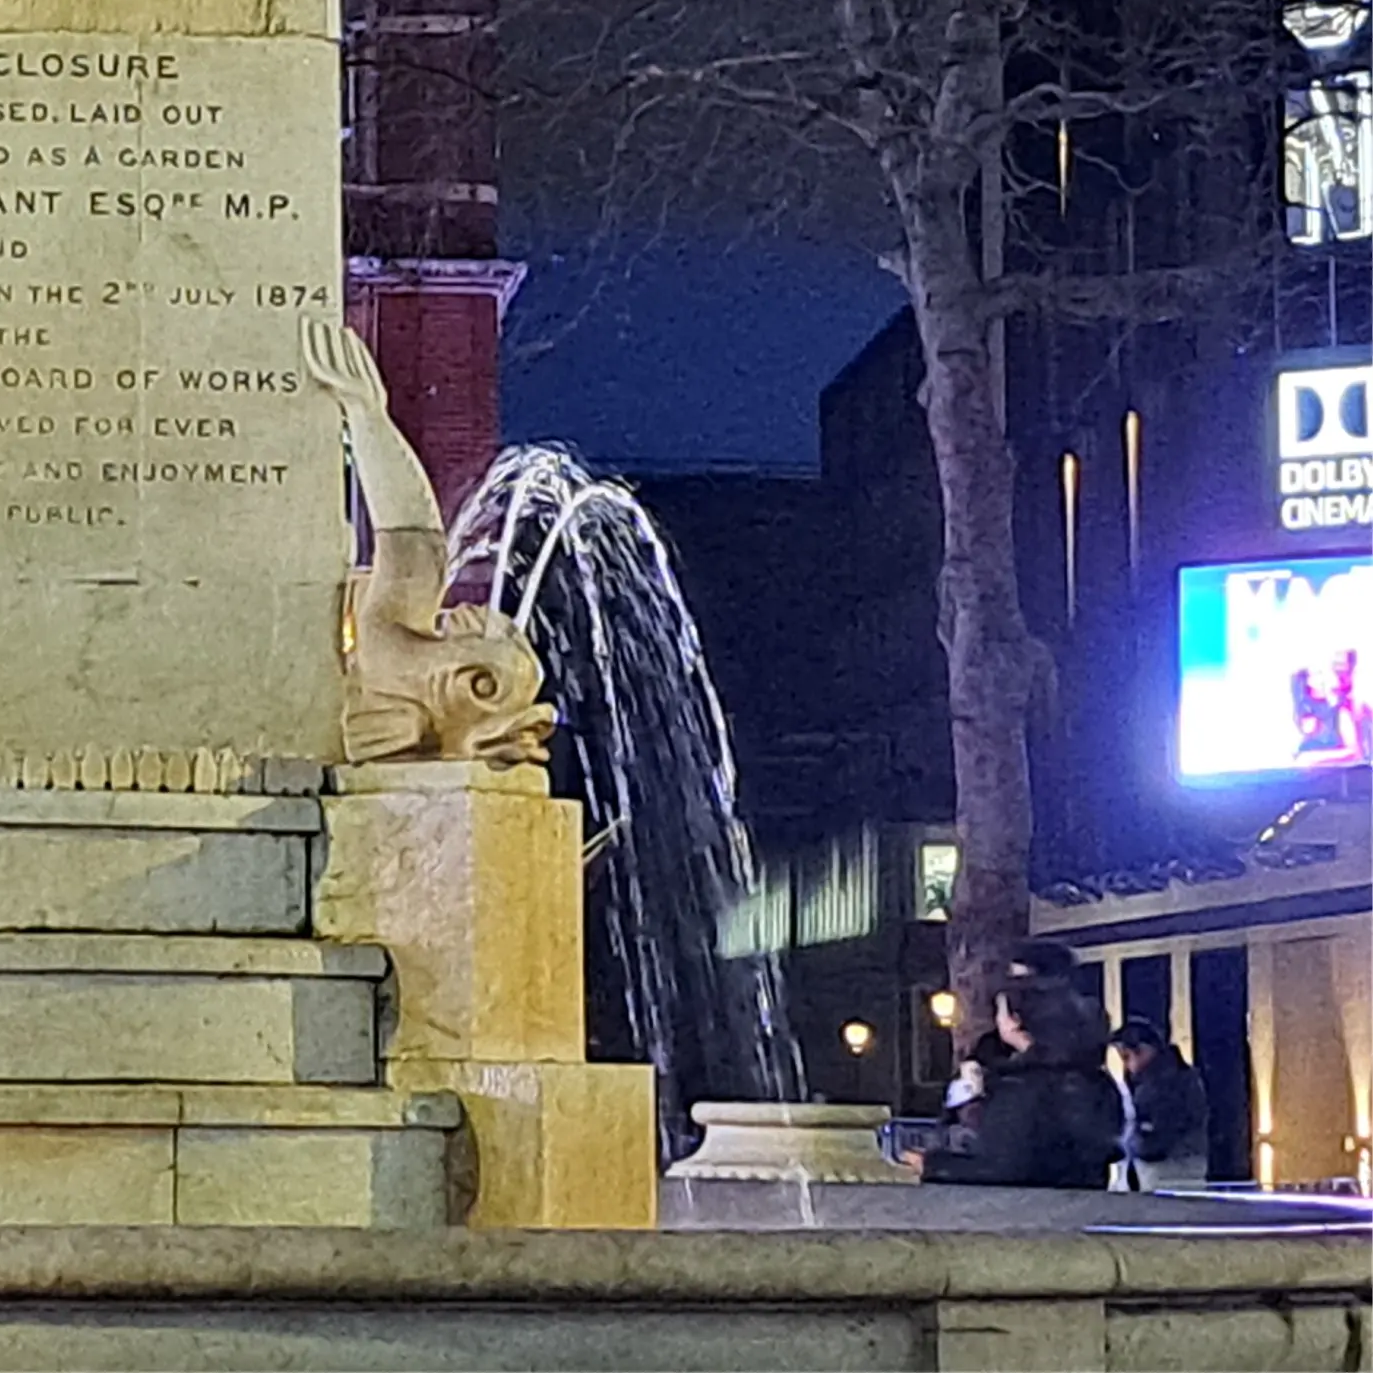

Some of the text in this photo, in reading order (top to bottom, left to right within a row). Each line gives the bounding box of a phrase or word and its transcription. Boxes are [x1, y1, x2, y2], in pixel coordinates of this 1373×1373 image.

[70, 102, 142, 124] LAID
[163, 105, 223, 125] OUT
[28, 146, 66, 166] AS
[83, 146, 102, 166] A
[118, 147, 245, 169] GARDEN
[225, 193, 299, 220] M.P.
[29, 285, 83, 304] THE
[169, 286, 235, 306] JULY
[256, 286, 328, 309] 1874
[116, 370, 158, 390] OF
[180, 370, 298, 393] WORKS
[75, 416, 134, 436] FOR
[154, 418, 236, 439] EVER
[102, 462, 288, 486] ENJOYMENT
[1280, 457, 1373, 494] DOLBY
